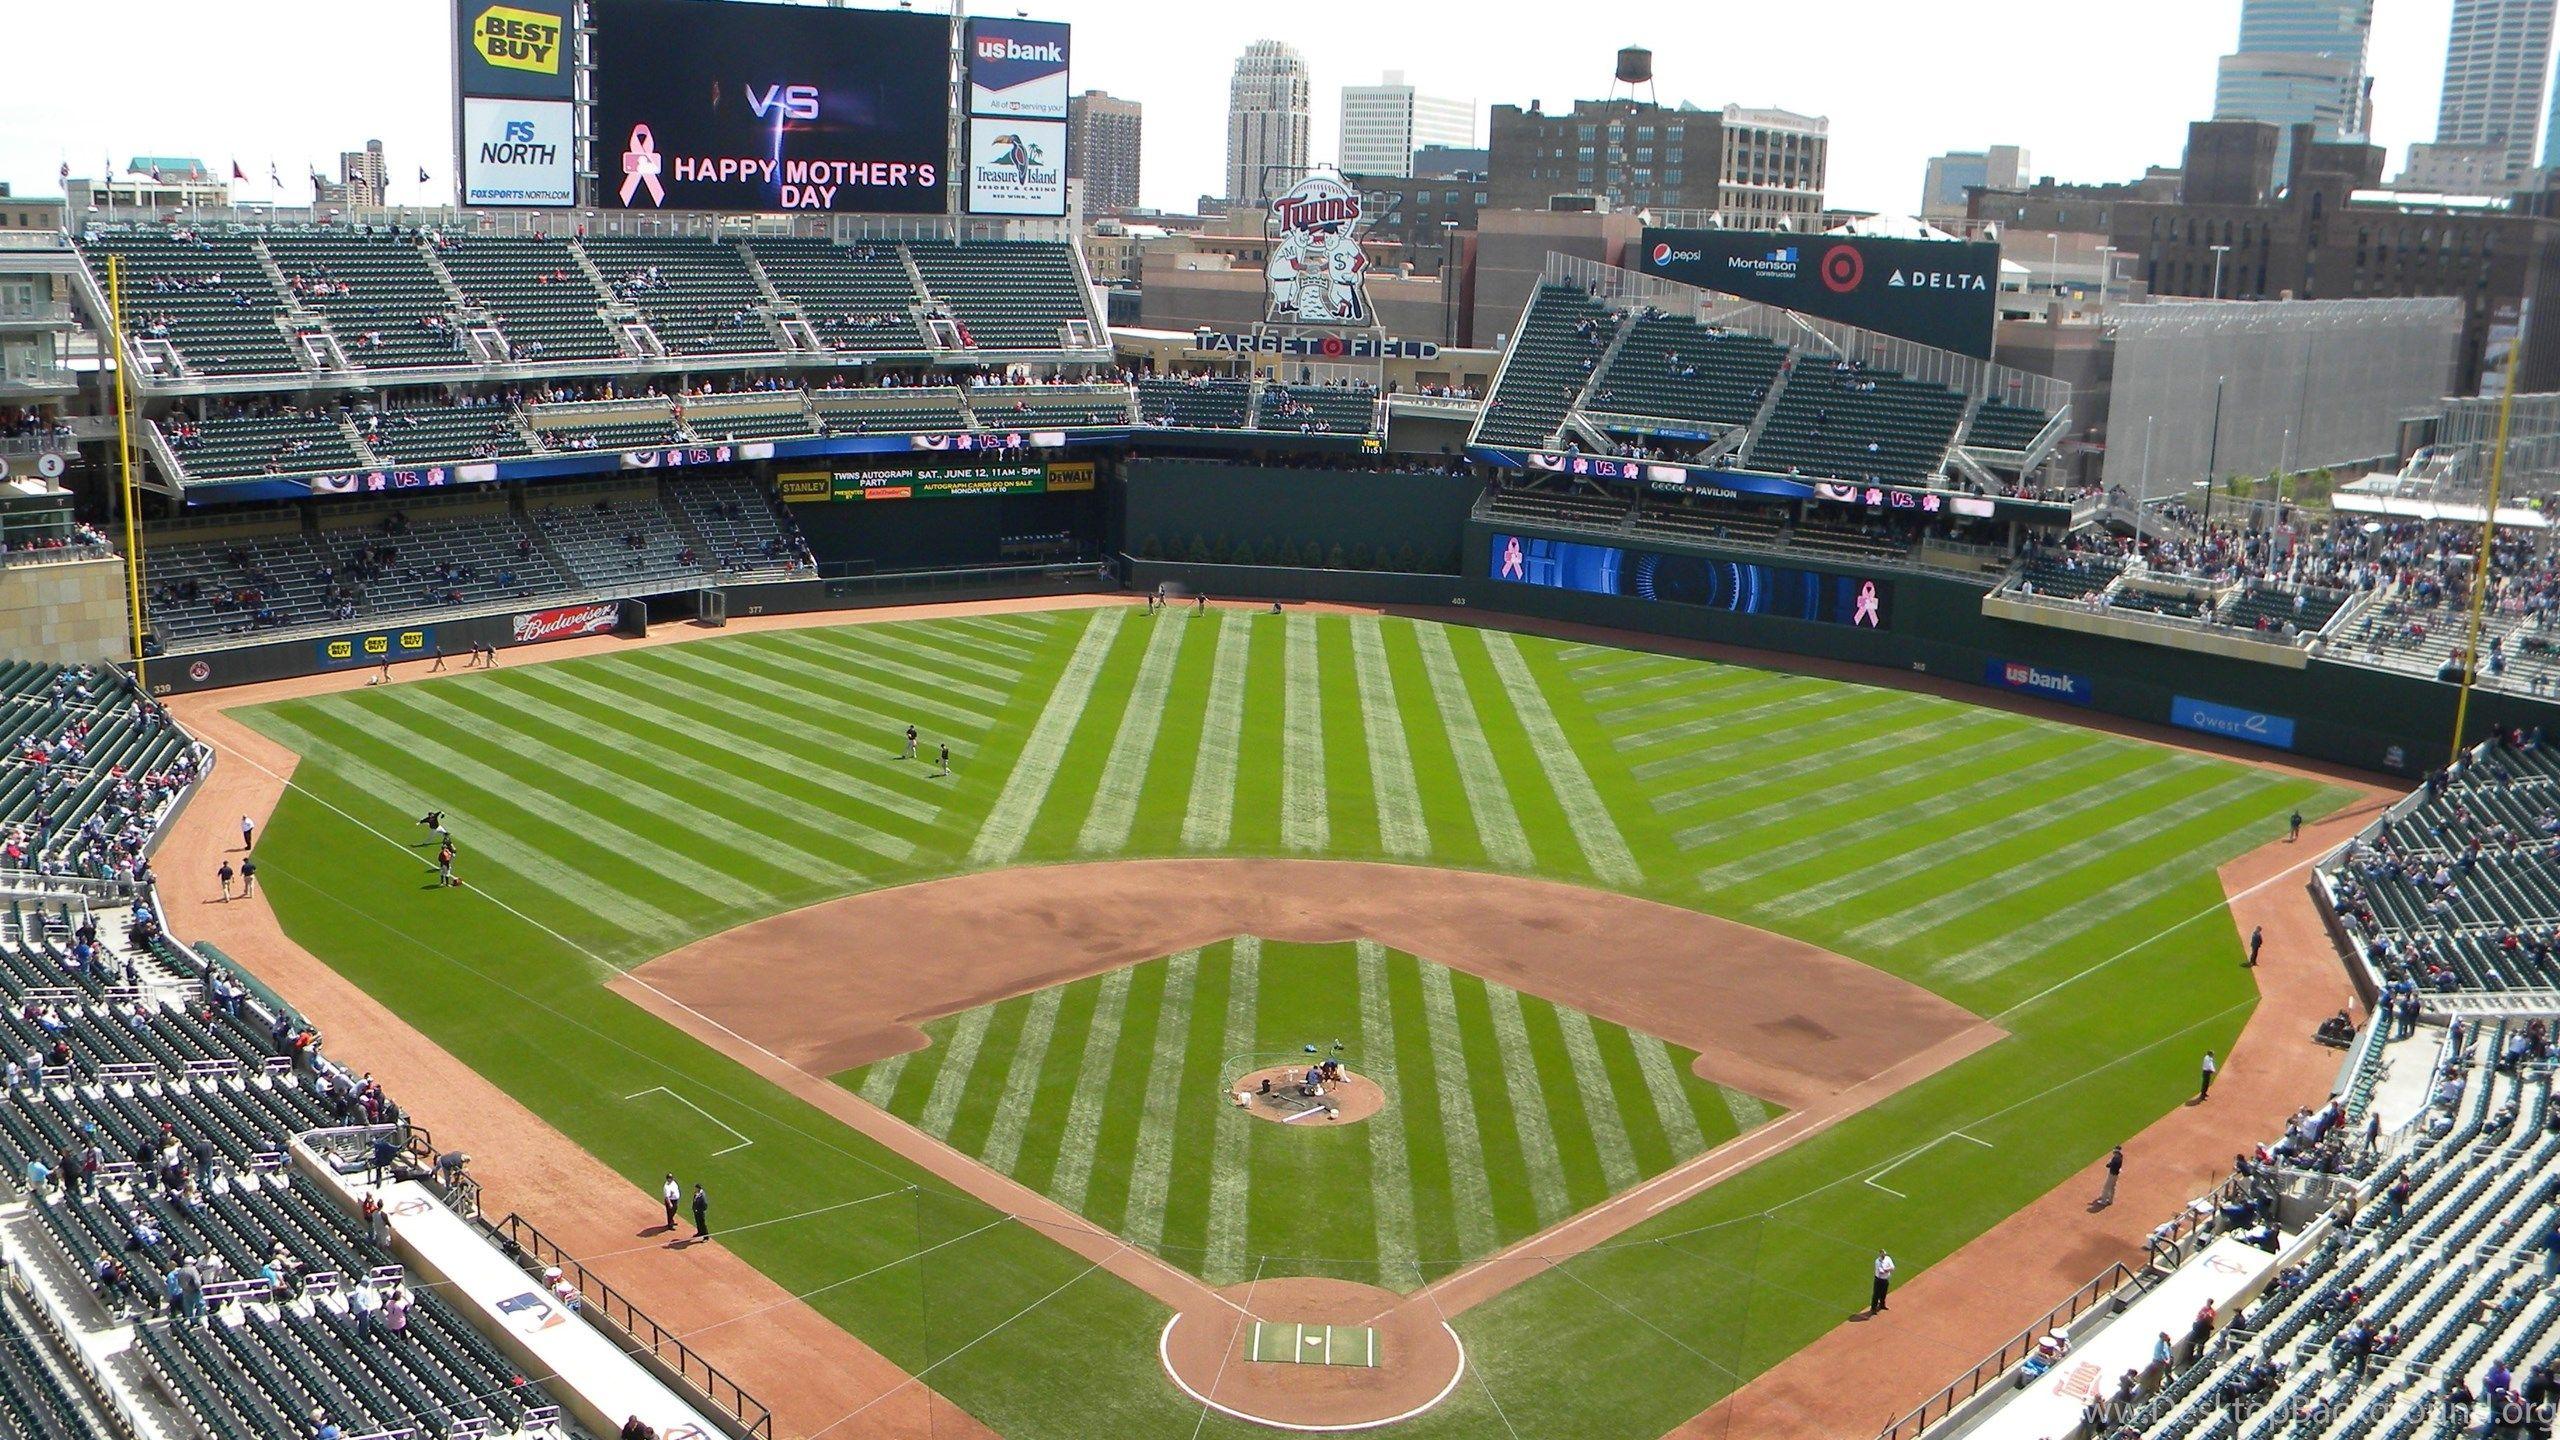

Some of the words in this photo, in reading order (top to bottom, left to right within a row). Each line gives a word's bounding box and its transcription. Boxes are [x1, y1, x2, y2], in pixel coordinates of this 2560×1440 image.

[486, 16, 558, 45] BEST
[488, 37, 551, 63] BUY
[746, 84, 819, 120] VS
[505, 121, 535, 143] FS
[480, 142, 556, 165] NORTH
[674, 156, 778, 184] HAPPY
[786, 160, 937, 187] MOTHER'S
[976, 166, 1018, 183] Treasure
[1027, 168, 1057, 184] Island
[781, 184, 838, 209] DAY
[1275, 192, 1360, 232] Twins
[1672, 250, 1701, 261] pepsi
[1728, 257, 1797, 272] Mortenson
[1755, 270, 1796, 279] construction
[1911, 272, 1986, 291] DELTA
[1196, 333, 1318, 356] TARGET
[1350, 338, 1440, 360] FIELD
[979, 434, 1000, 448] VS.
[1363, 439, 1380, 447] TIME
[689, 449, 710, 464] VS.
[47, 459, 55, 471] 3
[1595, 460, 1616, 476] VS.
[394, 471, 420, 488] VS.
[833, 472, 860, 481] TWINS
[861, 470, 913, 479] AUTOGRAPH
[944, 470, 972, 479] JUNE
[975, 469, 989, 478] 12,
[1021, 467, 1041, 476] 5PM
[783, 482, 825, 493] STANLEY
[860, 479, 888, 487] PARTY
[923, 482, 967, 490] AUTOGRAPH
[1695, 486, 1737, 498] PAVILION
[1890, 490, 1916, 508] VS.
[748, 606, 763, 614] 377
[522, 604, 612, 641] Budweiser
[367, 639, 386, 647] BEST
[401, 634, 421, 642] BEST
[154, 684, 171, 694] 339
[2193, 711, 2240, 733] Qwest
